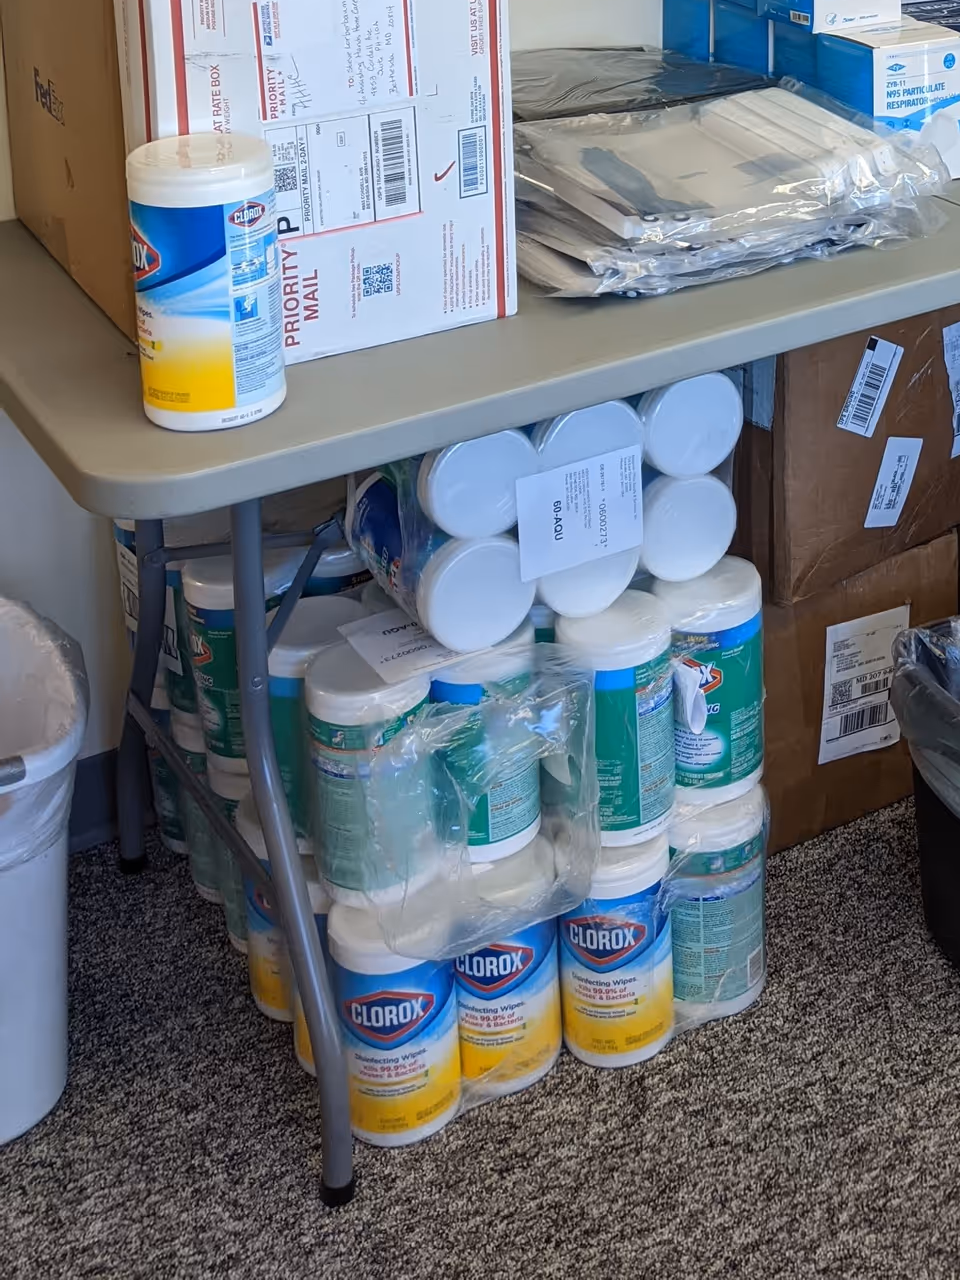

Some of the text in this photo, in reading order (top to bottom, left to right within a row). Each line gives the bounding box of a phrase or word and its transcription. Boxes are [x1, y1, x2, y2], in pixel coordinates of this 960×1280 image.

[469, 6, 477, 17] AT
[470, 19, 478, 32] US
[384, 5, 396, 95] Bethesda MD 20814
[470, 34, 478, 57] VISIT
[210, 64, 221, 86] BOX
[886, 79, 906, 88] ZYB-11
[210, 89, 222, 118] RATE
[266, 68, 279, 120] PRIORITY
[278, 78, 287, 107] MAIL
[886, 81, 946, 99] N95 PARTICULATE
[886, 97, 929, 110] RESPIRATOR
[222, 97, 231, 127] WEIGHT
[301, 170, 310, 189] MAIL
[234, 203, 264, 223] CLOROX
[301, 191, 312, 222] PRIORITY
[277, 216, 300, 234] P
[281, 248, 300, 348] PRIORITY
[302, 268, 319, 321] MAIL
[552, 500, 564, 541] 60-AQU
[569, 924, 637, 951] CLOROX
[455, 950, 524, 978] CLOROX
[572, 972, 612, 987] Disinfecting
[350, 995, 425, 1028] CLOROX
